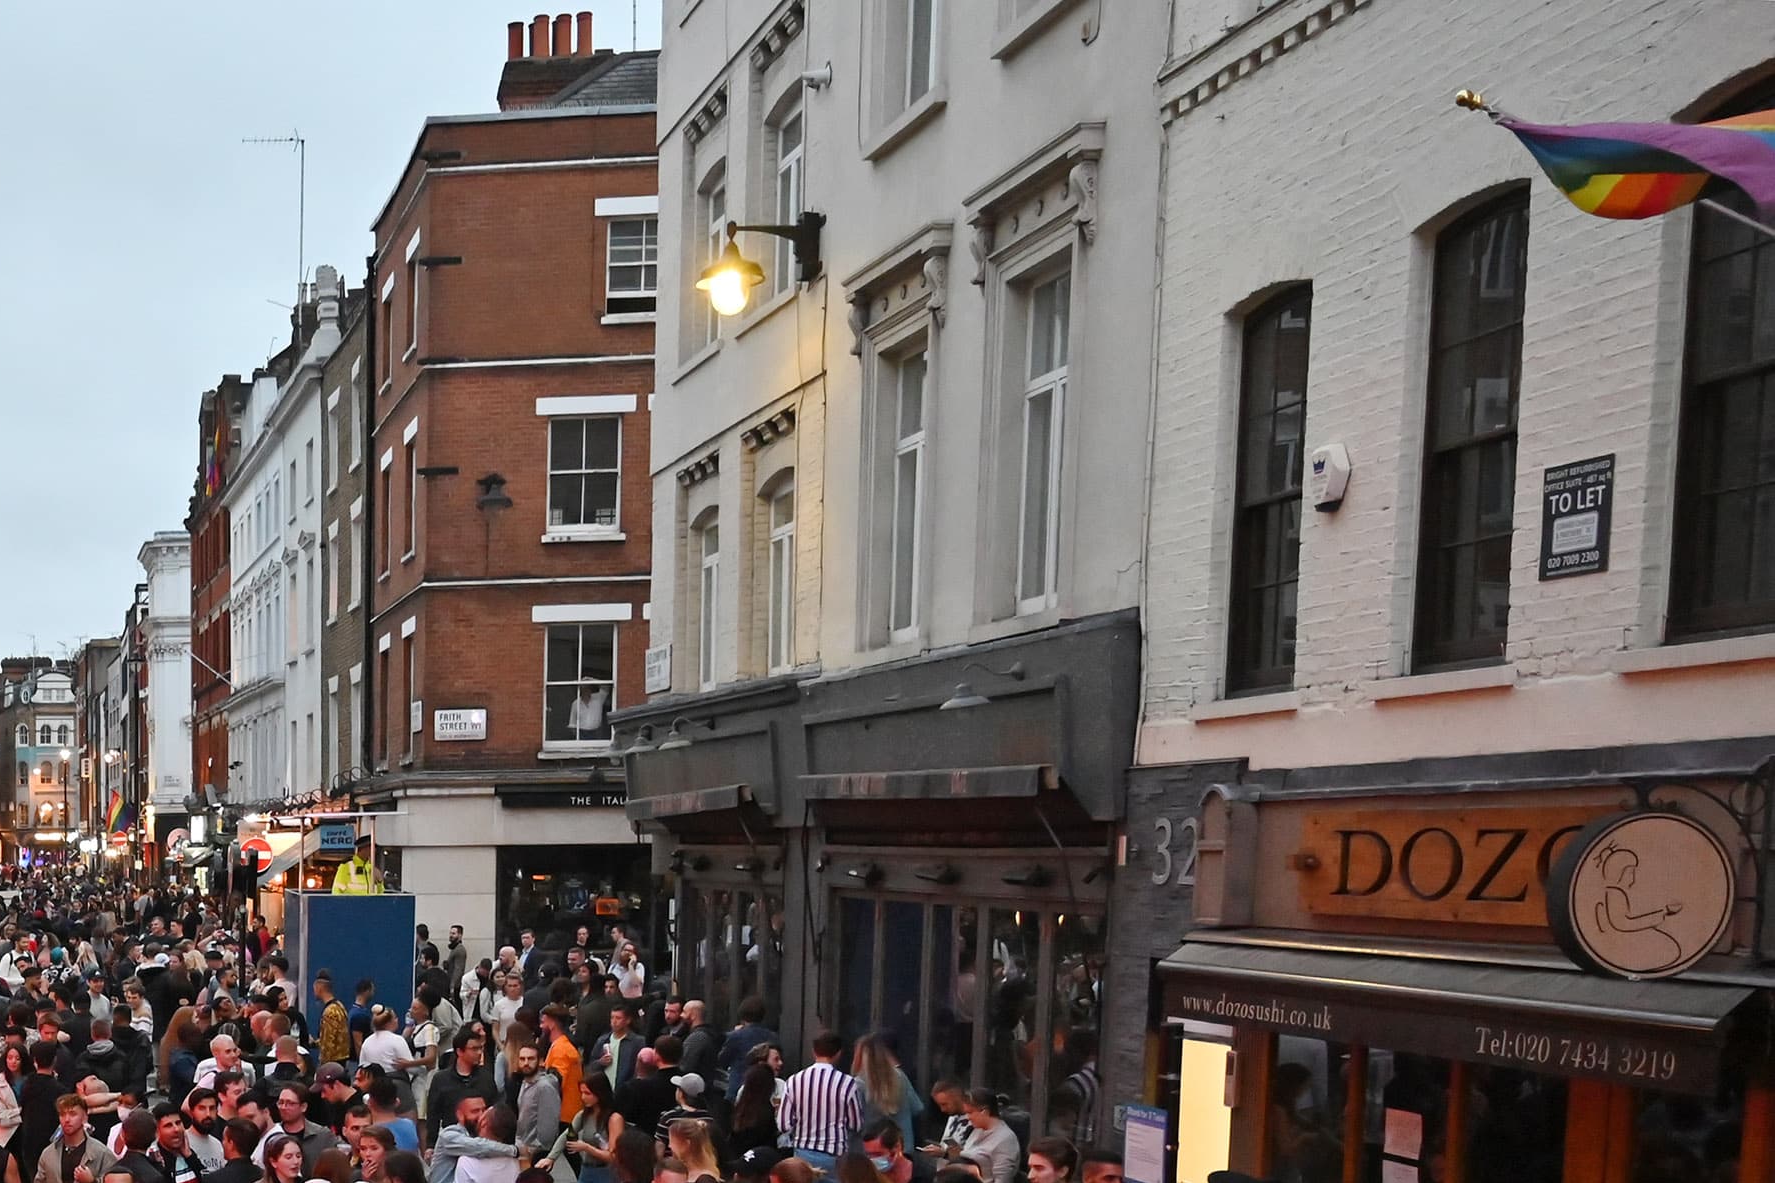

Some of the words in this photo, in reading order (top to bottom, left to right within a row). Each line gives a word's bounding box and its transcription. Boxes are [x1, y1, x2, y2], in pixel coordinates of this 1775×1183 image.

[1549, 492, 1572, 515] TO
[1576, 485, 1607, 510] LET
[439, 713, 462, 721] FRITH
[439, 722, 467, 731] STREET
[570, 796, 592, 806] THE
[321, 837, 353, 846] NERO
[1151, 816, 1198, 887] 32
[1182, 993, 1333, 1031] www.dozosushi.co.uk
[1475, 1026, 1551, 1064] Tel:020
[1559, 1039, 1610, 1073] 7434
[1618, 1048, 1676, 1081] 3219
